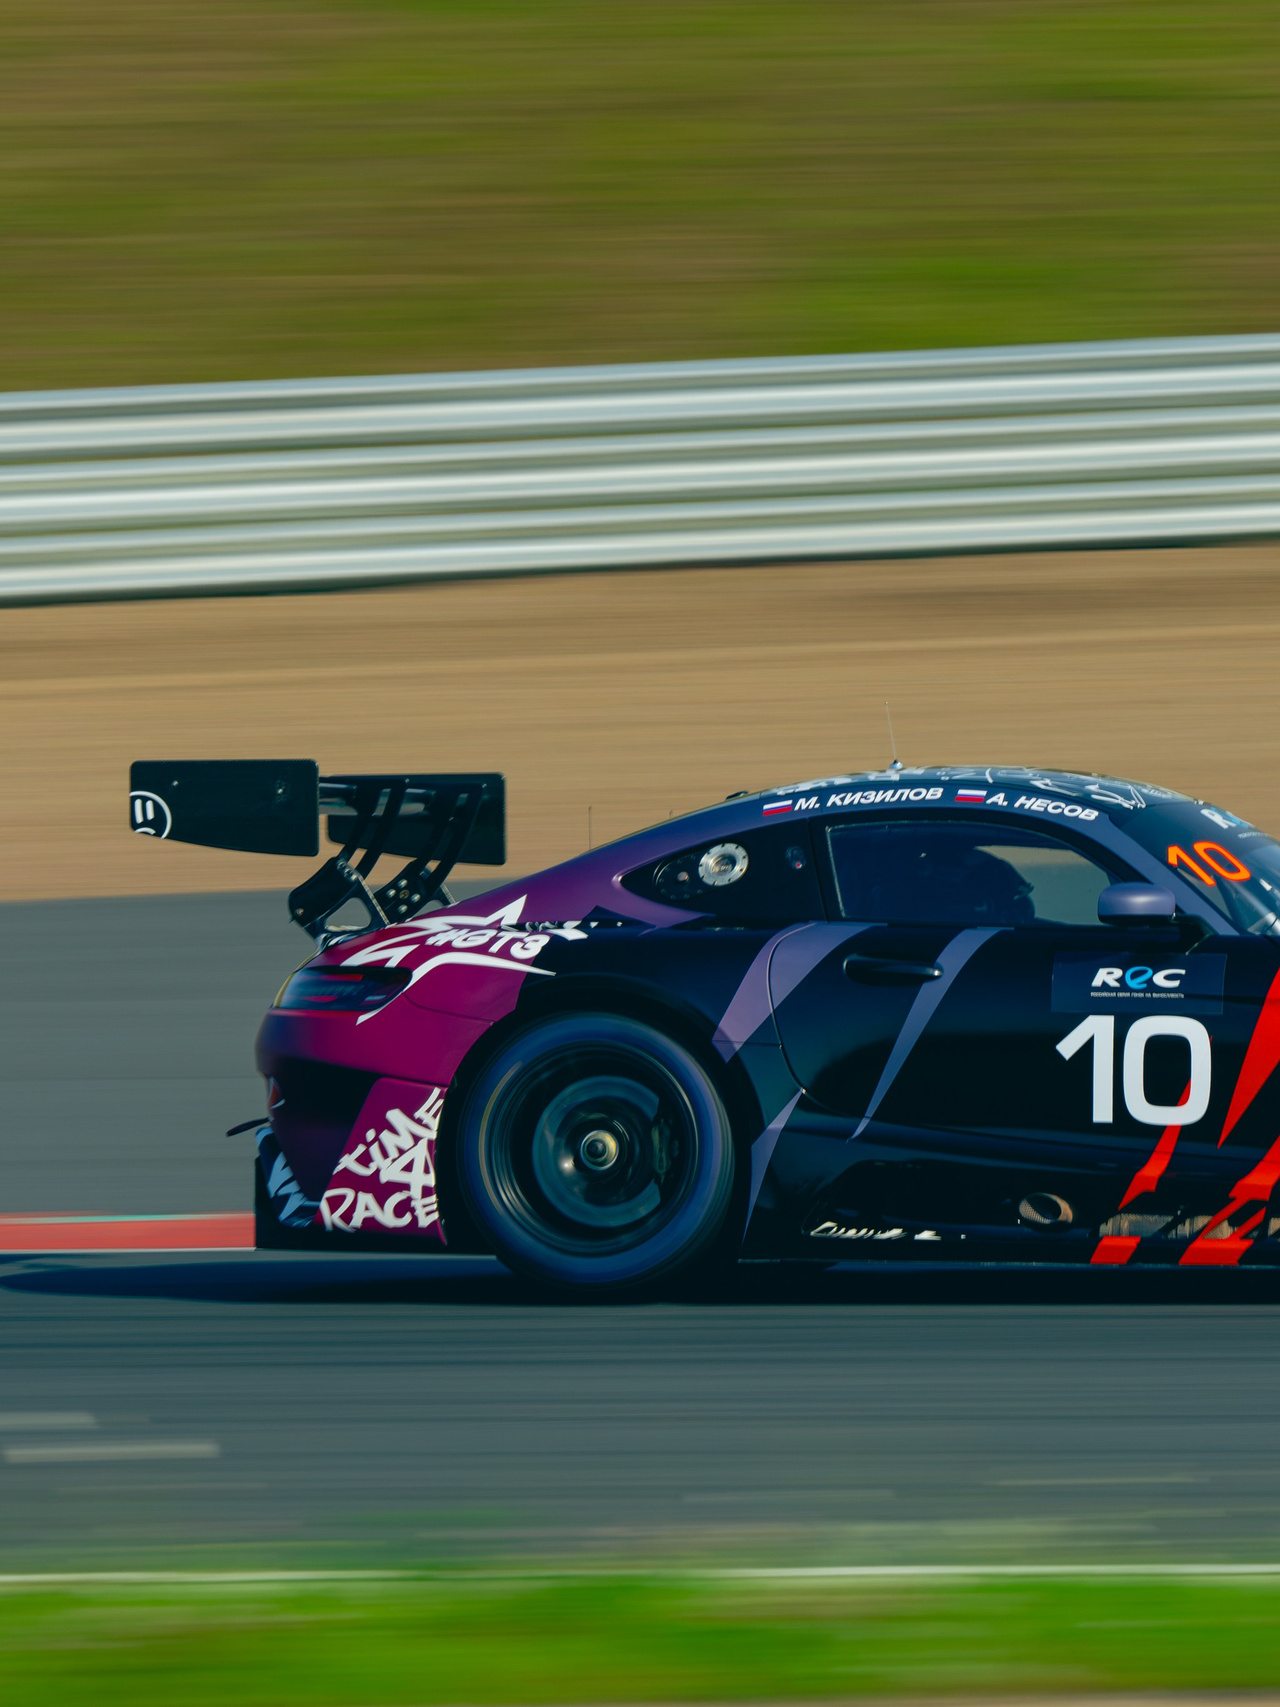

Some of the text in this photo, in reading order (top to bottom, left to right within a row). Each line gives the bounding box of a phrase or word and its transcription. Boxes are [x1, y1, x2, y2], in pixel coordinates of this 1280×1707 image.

[793, 787, 945, 812] М. КИЗИЛОВ
[985, 792, 1099, 822] А. НЕСОВ
[1167, 841, 1251, 887] 10
[1055, 1014, 1212, 1126] 10
[379, 1137, 436, 1201] 4
[319, 1187, 439, 1233] RACE
